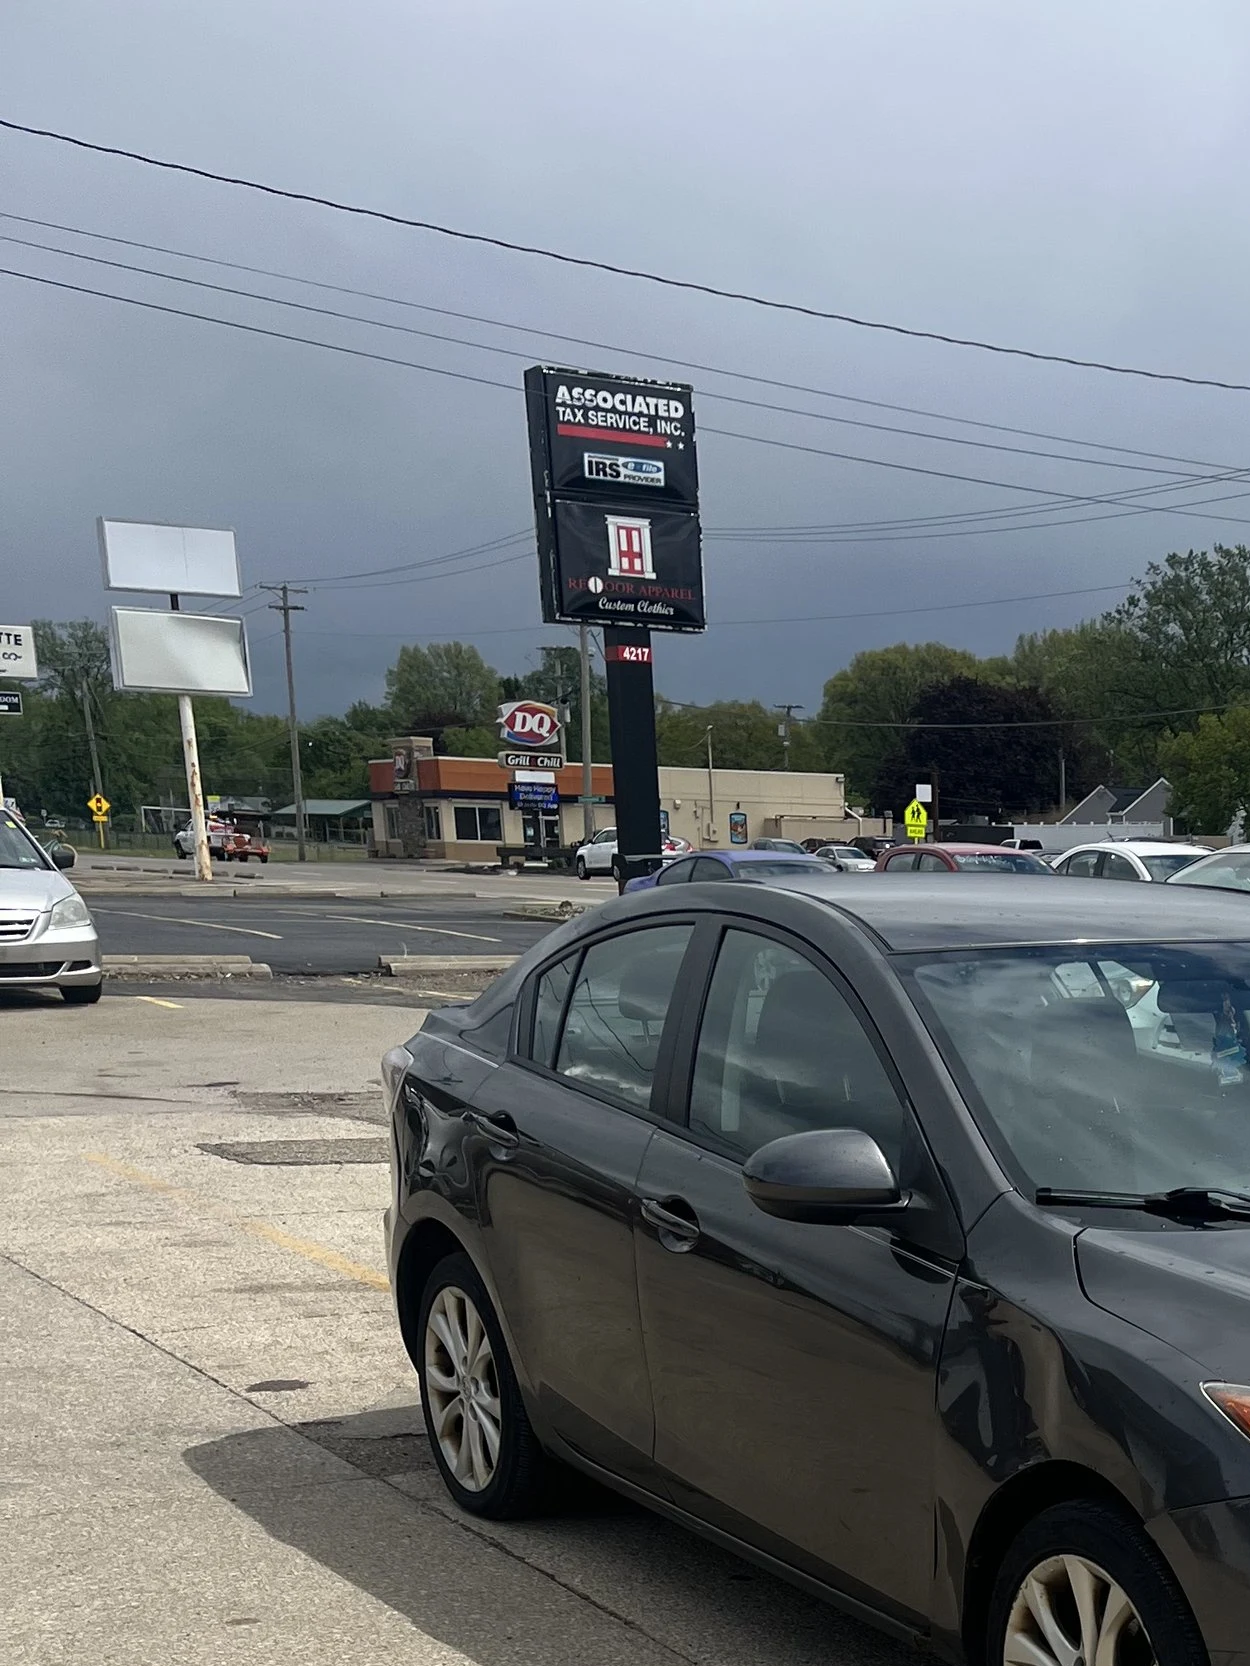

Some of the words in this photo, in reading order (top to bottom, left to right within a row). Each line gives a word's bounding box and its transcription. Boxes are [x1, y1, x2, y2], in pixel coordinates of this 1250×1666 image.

[555, 385, 684, 419] ASSOCIATED
[555, 406, 584, 424] TAX
[588, 410, 654, 435] SERVICE,
[657, 419, 685, 437] INC.
[587, 459, 621, 479] IRS
[624, 473, 662, 484] PROVIDER
[639, 585, 696, 600] APPAREL
[598, 596, 635, 612] Custom
[637, 599, 675, 615] Clothier
[623, 646, 650, 661] 4217
[513, 711, 551, 738] DQ
[507, 755, 530, 766] Grill
[537, 757, 561, 768] Chill
